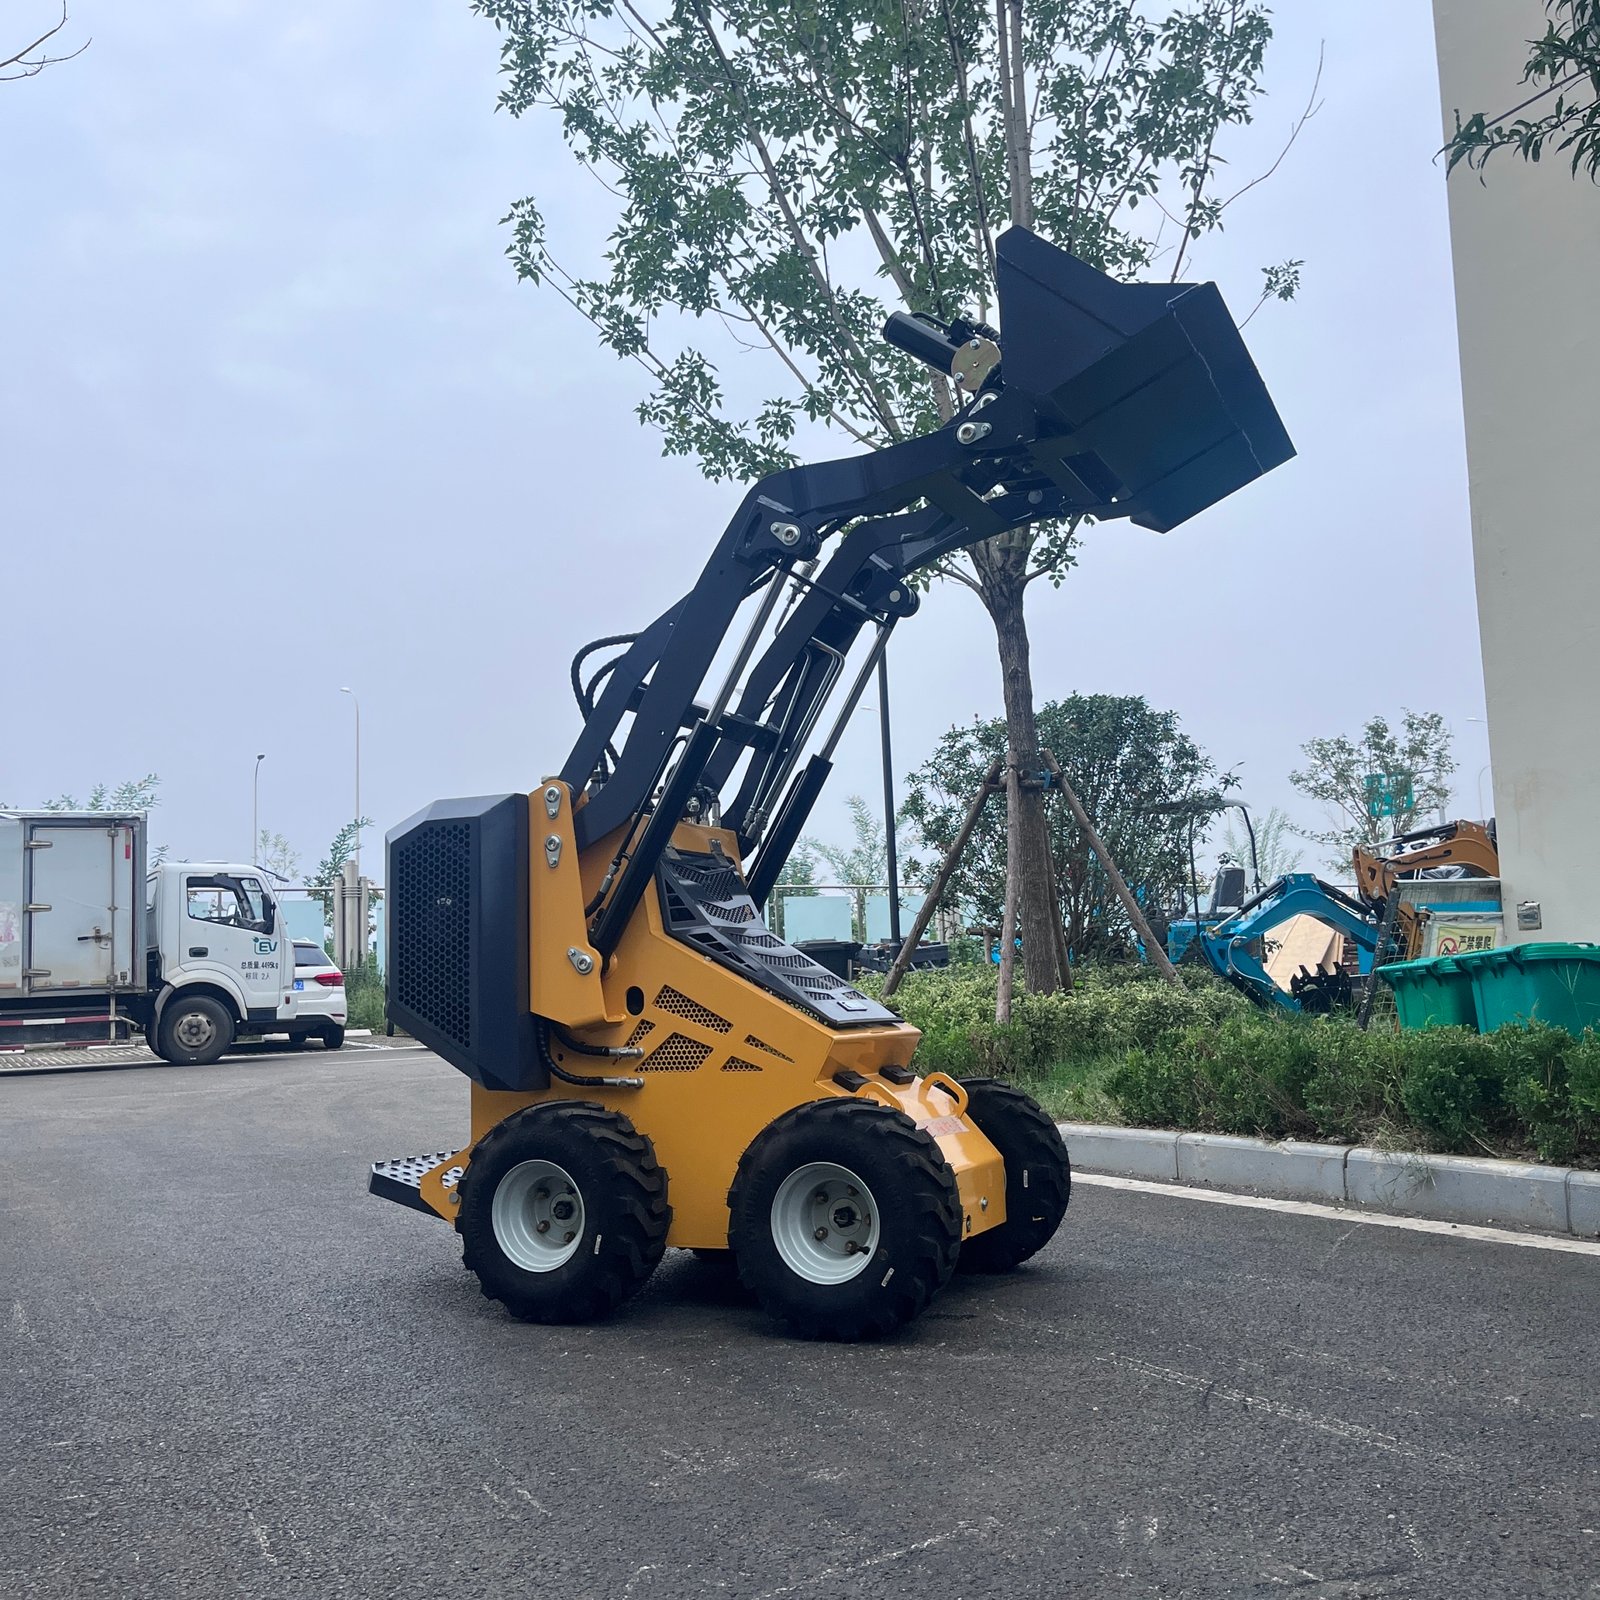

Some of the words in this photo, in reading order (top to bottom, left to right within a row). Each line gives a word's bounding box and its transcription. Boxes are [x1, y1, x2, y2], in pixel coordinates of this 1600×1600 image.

[259, 941, 278, 952] EV
[1458, 935, 1492, 950] 严禁攀爬
